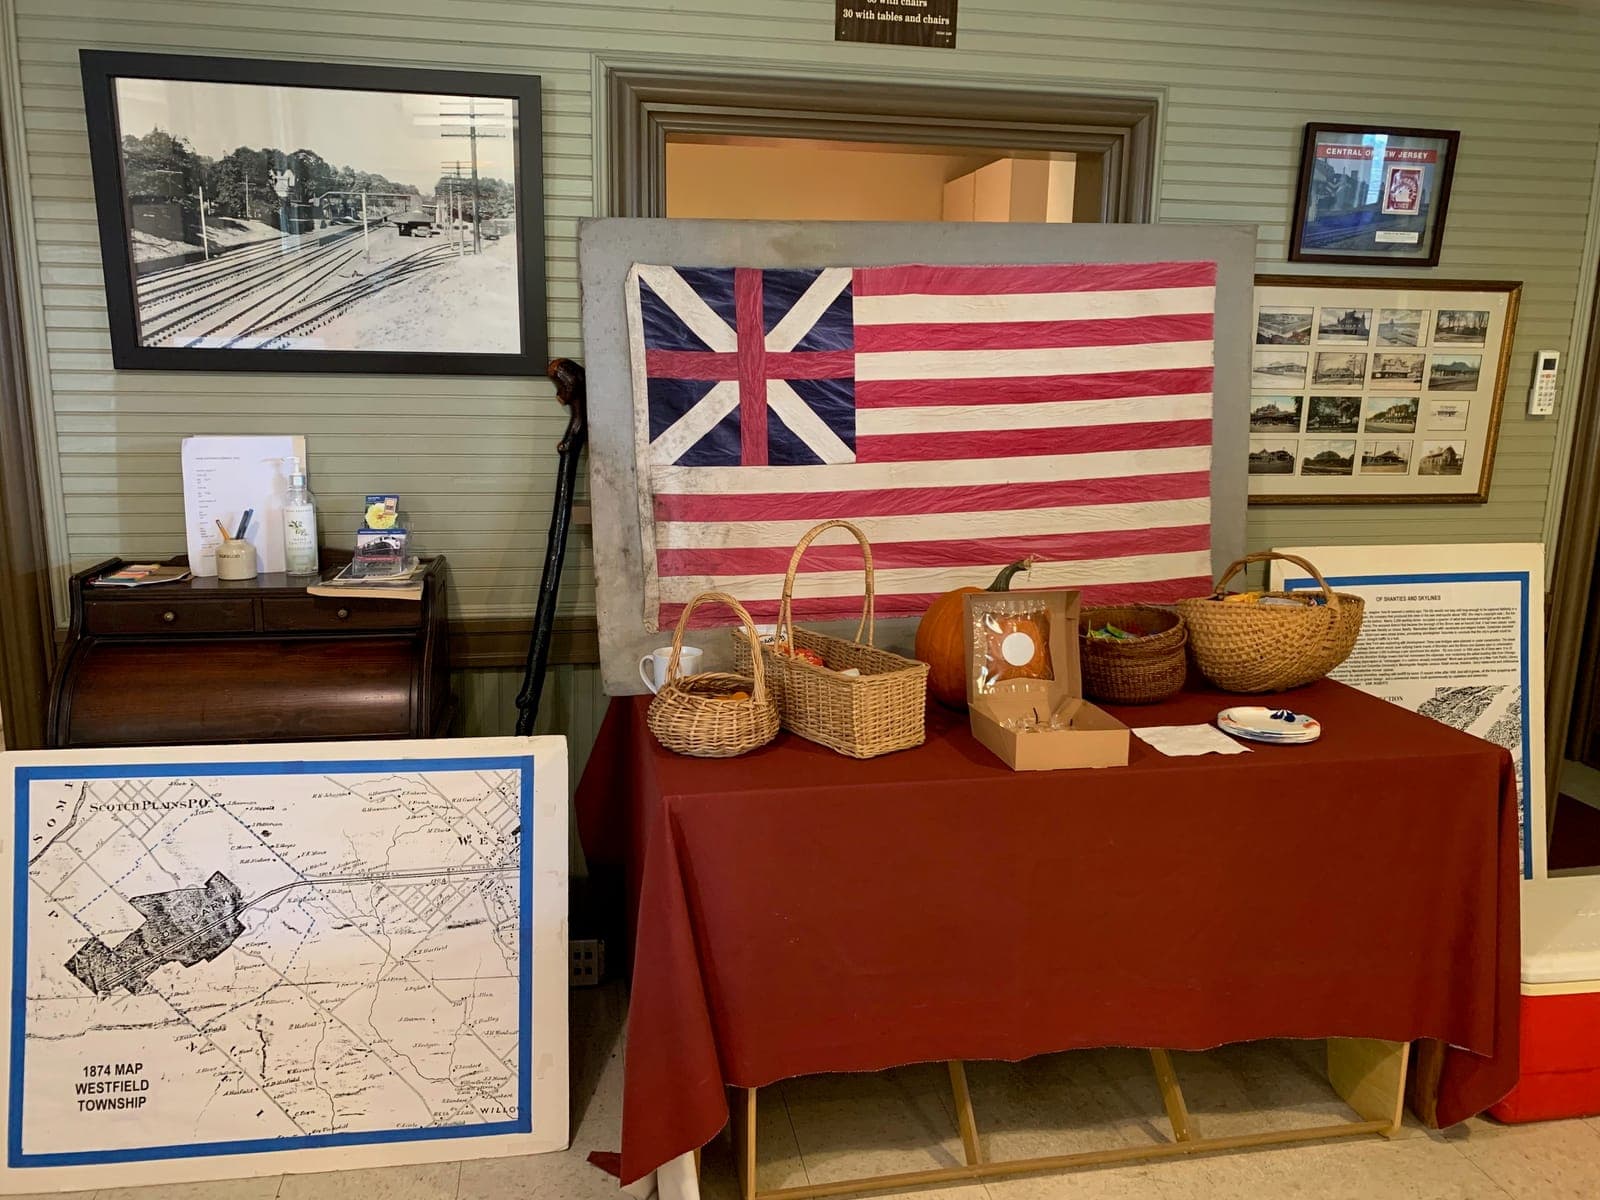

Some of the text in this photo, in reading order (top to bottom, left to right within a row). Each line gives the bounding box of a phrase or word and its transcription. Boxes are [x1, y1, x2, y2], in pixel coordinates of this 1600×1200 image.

[843, 9, 950, 25] 30 with tables and chairs
[1326, 148, 1362, 156] CENTRAL
[1398, 150, 1428, 160] JERSEY
[83, 1063, 143, 1078] 1874 MAP
[76, 1080, 149, 1095] WESTFIELD
[78, 1097, 146, 1111] TOWNSHIP
[480, 1106, 517, 1114] WILLO
